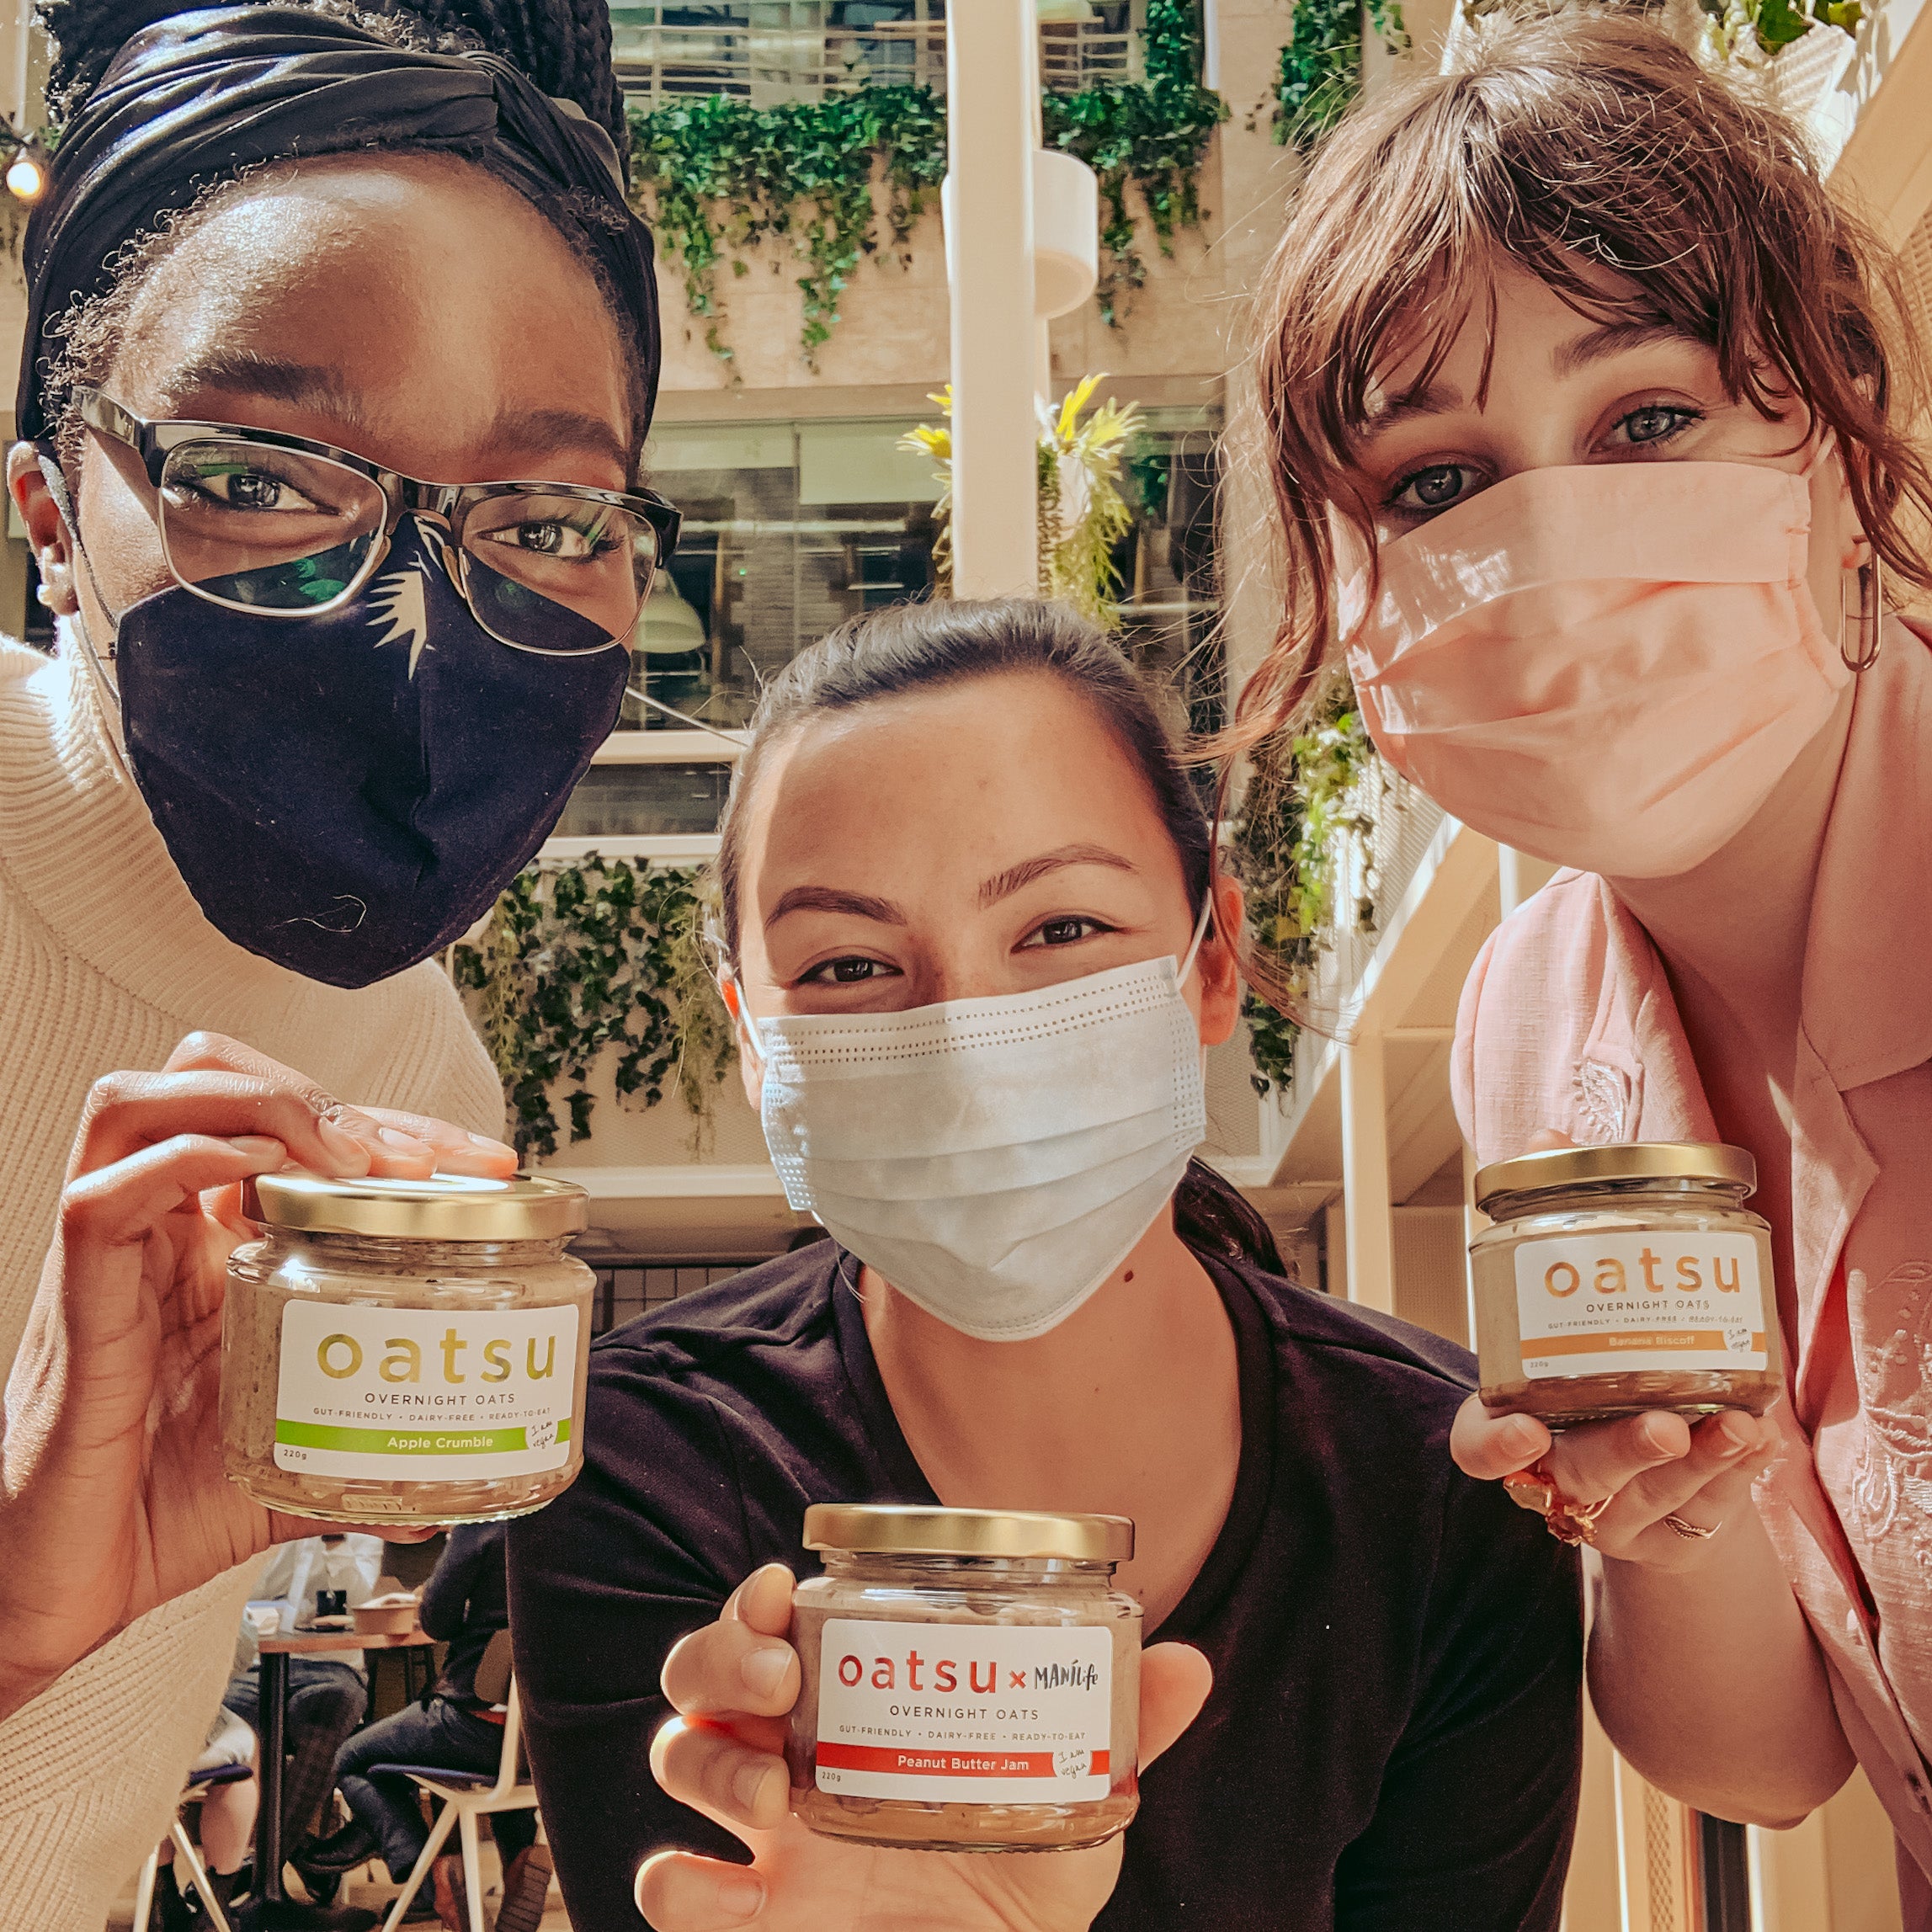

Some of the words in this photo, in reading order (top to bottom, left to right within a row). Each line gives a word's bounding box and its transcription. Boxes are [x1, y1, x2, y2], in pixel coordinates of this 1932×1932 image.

[1544, 1247, 1740, 1298] oatsu
[1586, 1300, 1669, 1312] OVERNIGHT
[1676, 1300, 1710, 1310] OATS
[1609, 1337, 1653, 1346] Banana
[1655, 1336, 1695, 1345] Biscoff
[317, 1328, 556, 1384] oatsu
[365, 1393, 467, 1406] OVERNIGHT
[476, 1393, 515, 1404] OATS
[313, 1408, 392, 1421] GUT-FRIENDLY
[409, 1413, 475, 1422] DAIRY-FREE
[387, 1436, 430, 1450] Apple
[436, 1436, 493, 1448] Crumble
[284, 1449, 307, 1461] 220g
[838, 1650, 997, 1694] oatsu
[890, 1705, 987, 1720] OVERNIGHT
[996, 1709, 1039, 1720] OATS
[839, 1725, 911, 1738] GUT-FRIENDLY
[929, 1731, 996, 1741] DAIRY-FREE
[1012, 1732, 1085, 1741] READY-TO-EAT
[897, 1755, 947, 1769] Peanut
[951, 1757, 996, 1770] Butter
[1001, 1759, 1029, 1771] Jam
[822, 1771, 841, 1782] 220g
